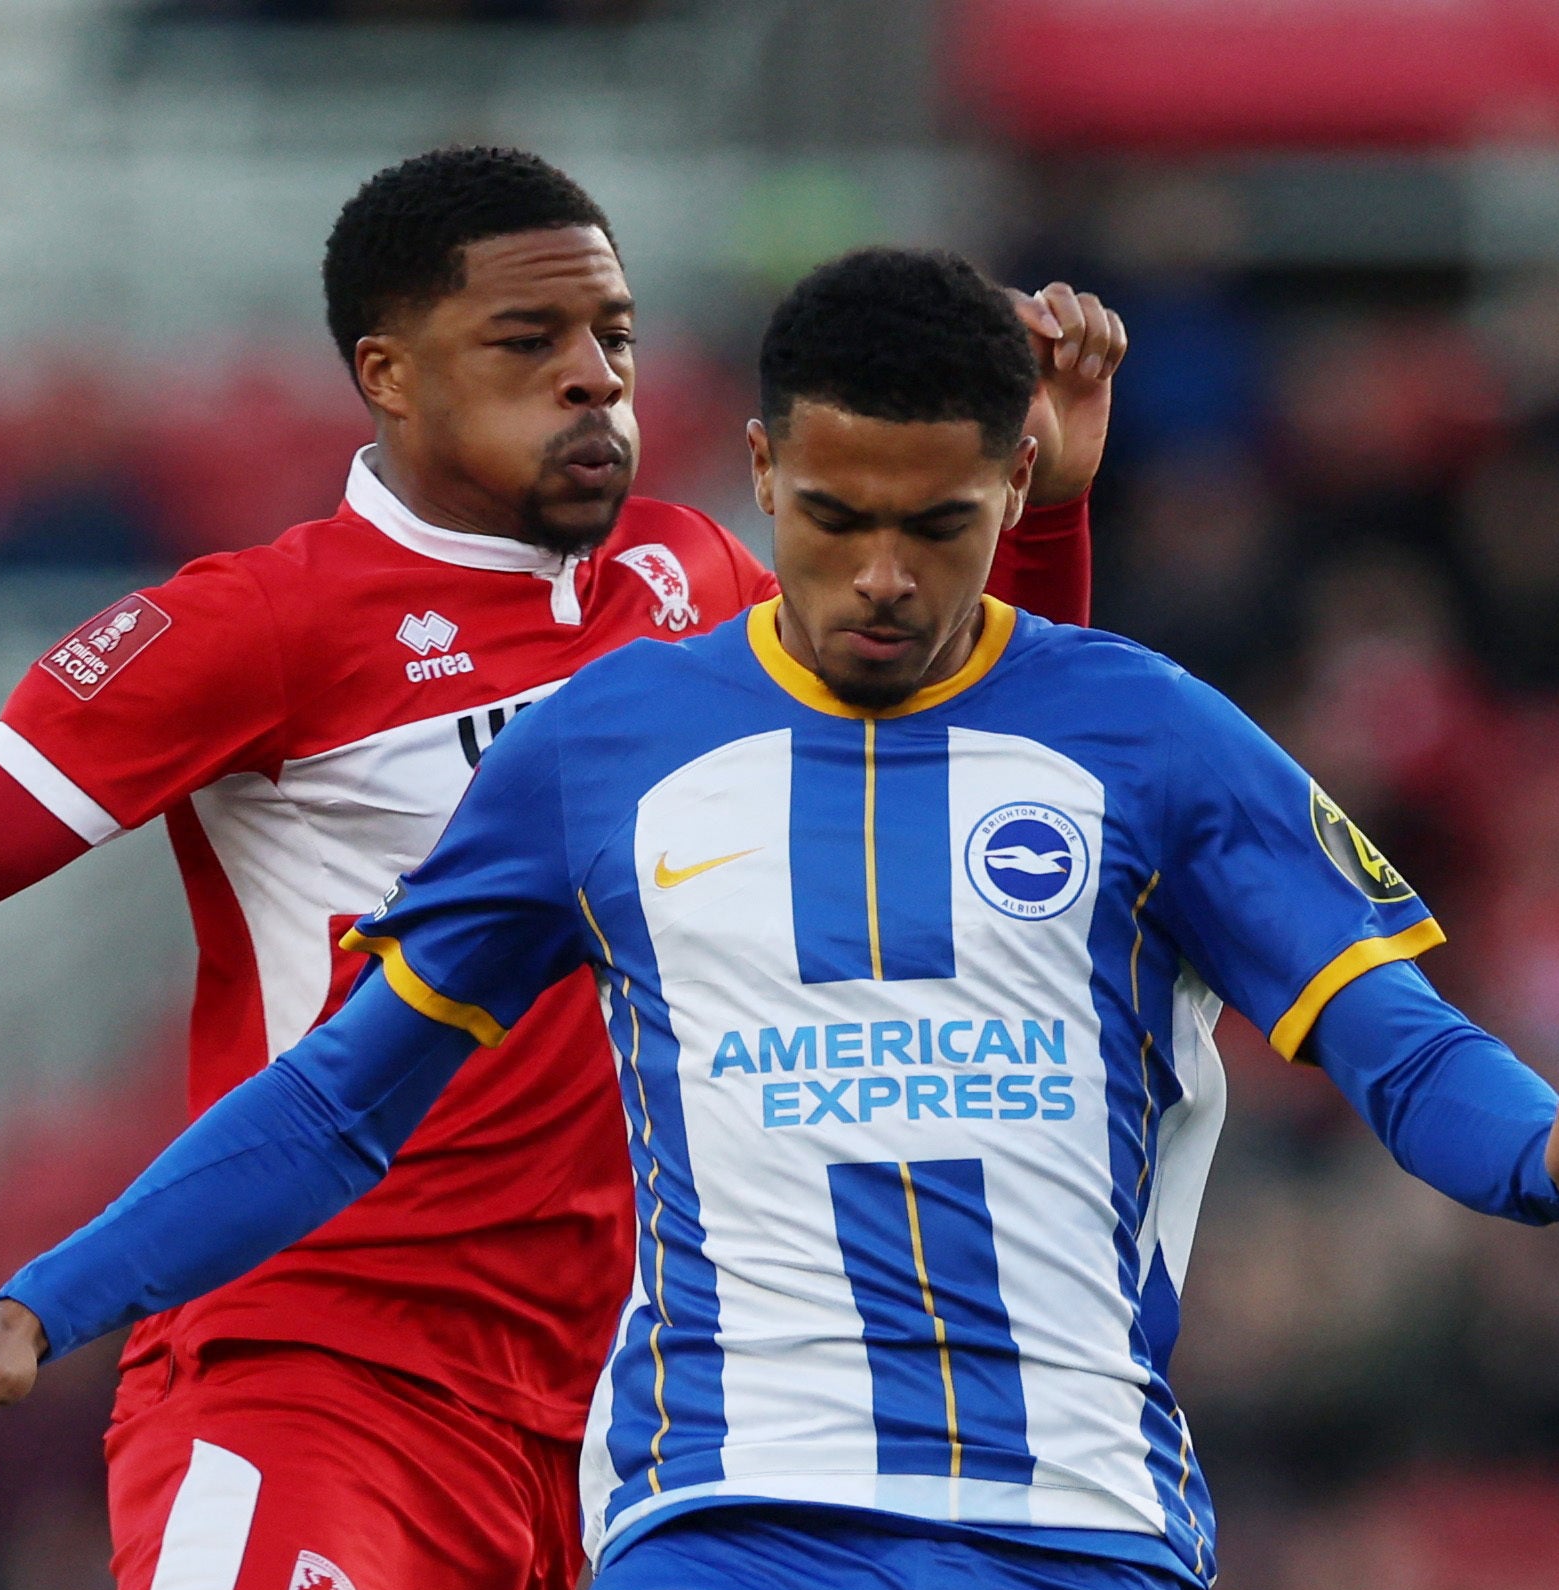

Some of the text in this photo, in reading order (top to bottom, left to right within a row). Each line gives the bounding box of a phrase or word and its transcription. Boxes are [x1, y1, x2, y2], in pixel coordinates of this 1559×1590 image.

[50, 649, 99, 685] FA CUP
[65, 638, 109, 675] Emirates
[405, 651, 475, 683] errea
[982, 808, 1037, 835] BRIGHTON
[1054, 818, 1078, 843] HOVE
[1002, 899, 1046, 914] ALBION
[710, 1018, 1068, 1079] AMERICAN
[762, 1074, 1076, 1129] EXPRESS
